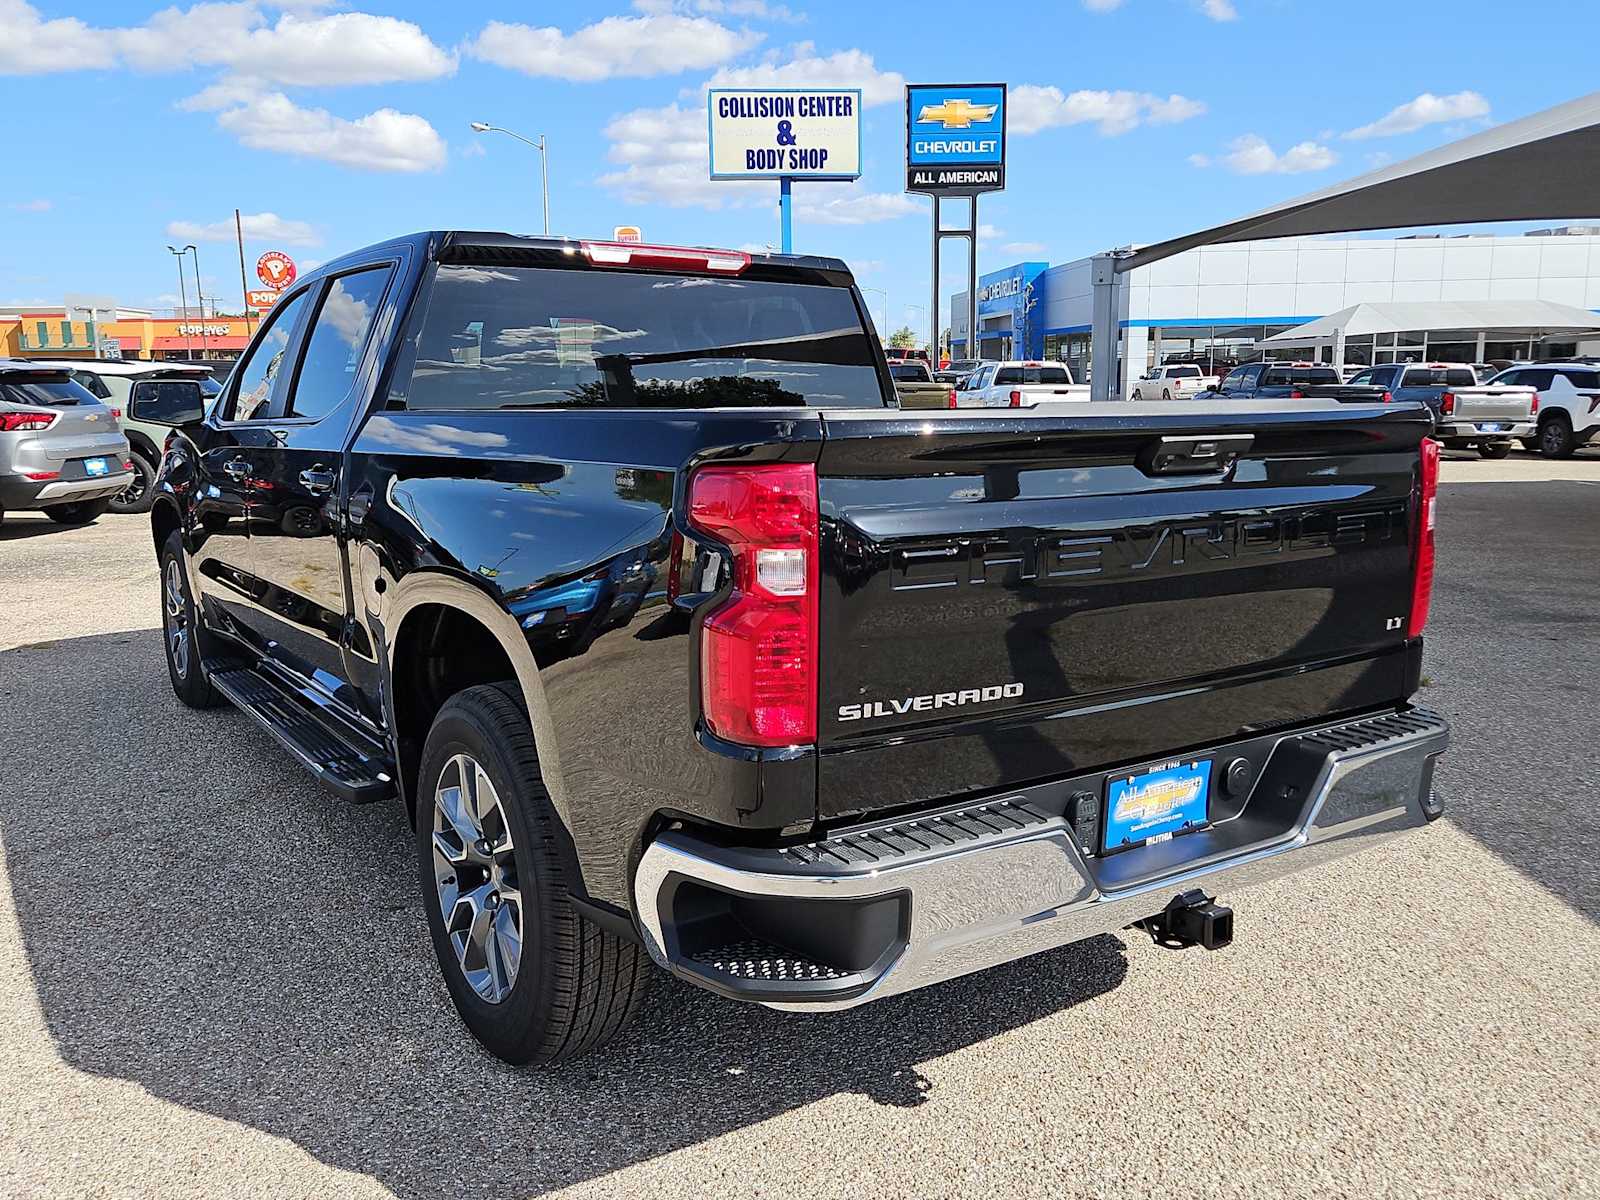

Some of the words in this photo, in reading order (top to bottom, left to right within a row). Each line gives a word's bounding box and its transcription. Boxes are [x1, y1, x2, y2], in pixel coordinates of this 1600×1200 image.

[719, 97, 794, 118] COLLISION
[799, 96, 852, 117] CENTER
[777, 120, 797, 146] &
[915, 140, 997, 154] CHEVROLET
[746, 149, 785, 170] BODY
[789, 148, 828, 169] SHOP
[914, 172, 936, 184] ALL
[938, 171, 998, 184] AMERICAN
[889, 506, 1405, 592] CHEVROLET
[1386, 616, 1405, 630] LT
[838, 682, 1024, 722] SILVERADO
